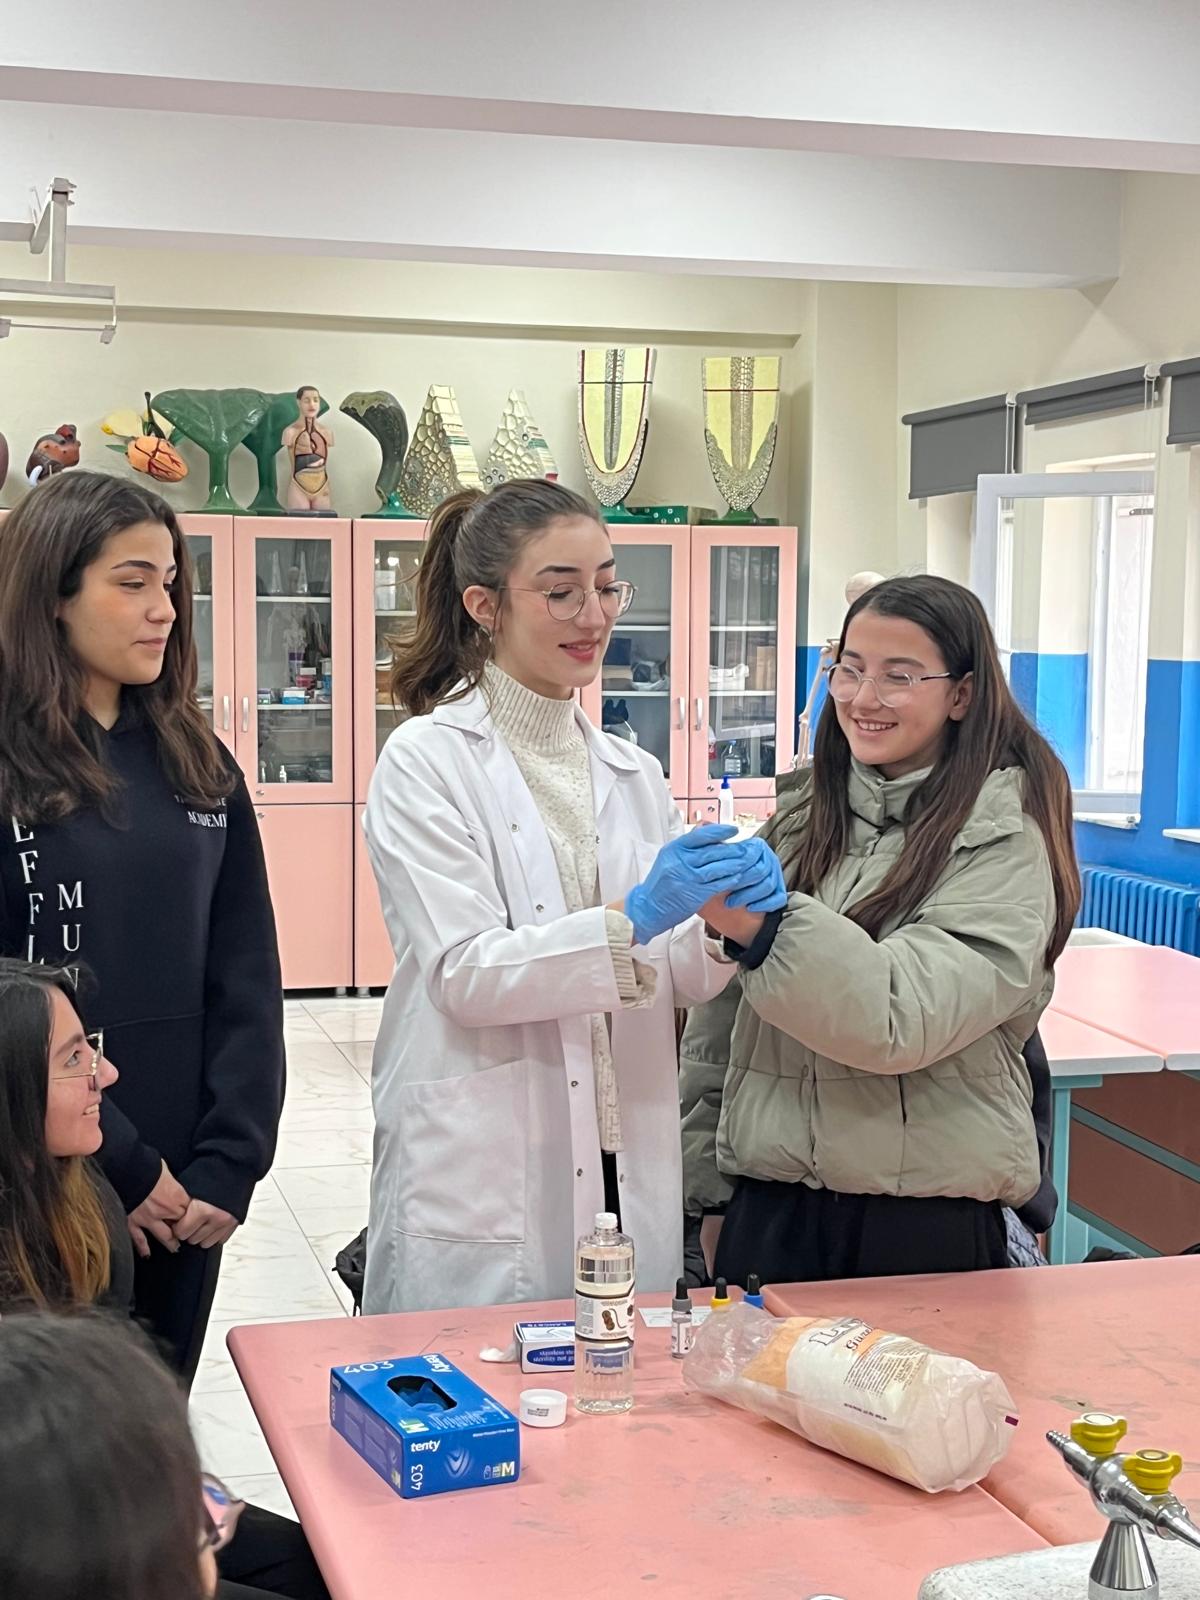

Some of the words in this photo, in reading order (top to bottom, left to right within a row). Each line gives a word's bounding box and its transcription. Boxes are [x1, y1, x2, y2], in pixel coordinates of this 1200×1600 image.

[343, 1360, 395, 1374] 403
[410, 1440, 441, 1453] tenty
[501, 1461, 516, 1477] M
[410, 1463, 424, 1491] 403
